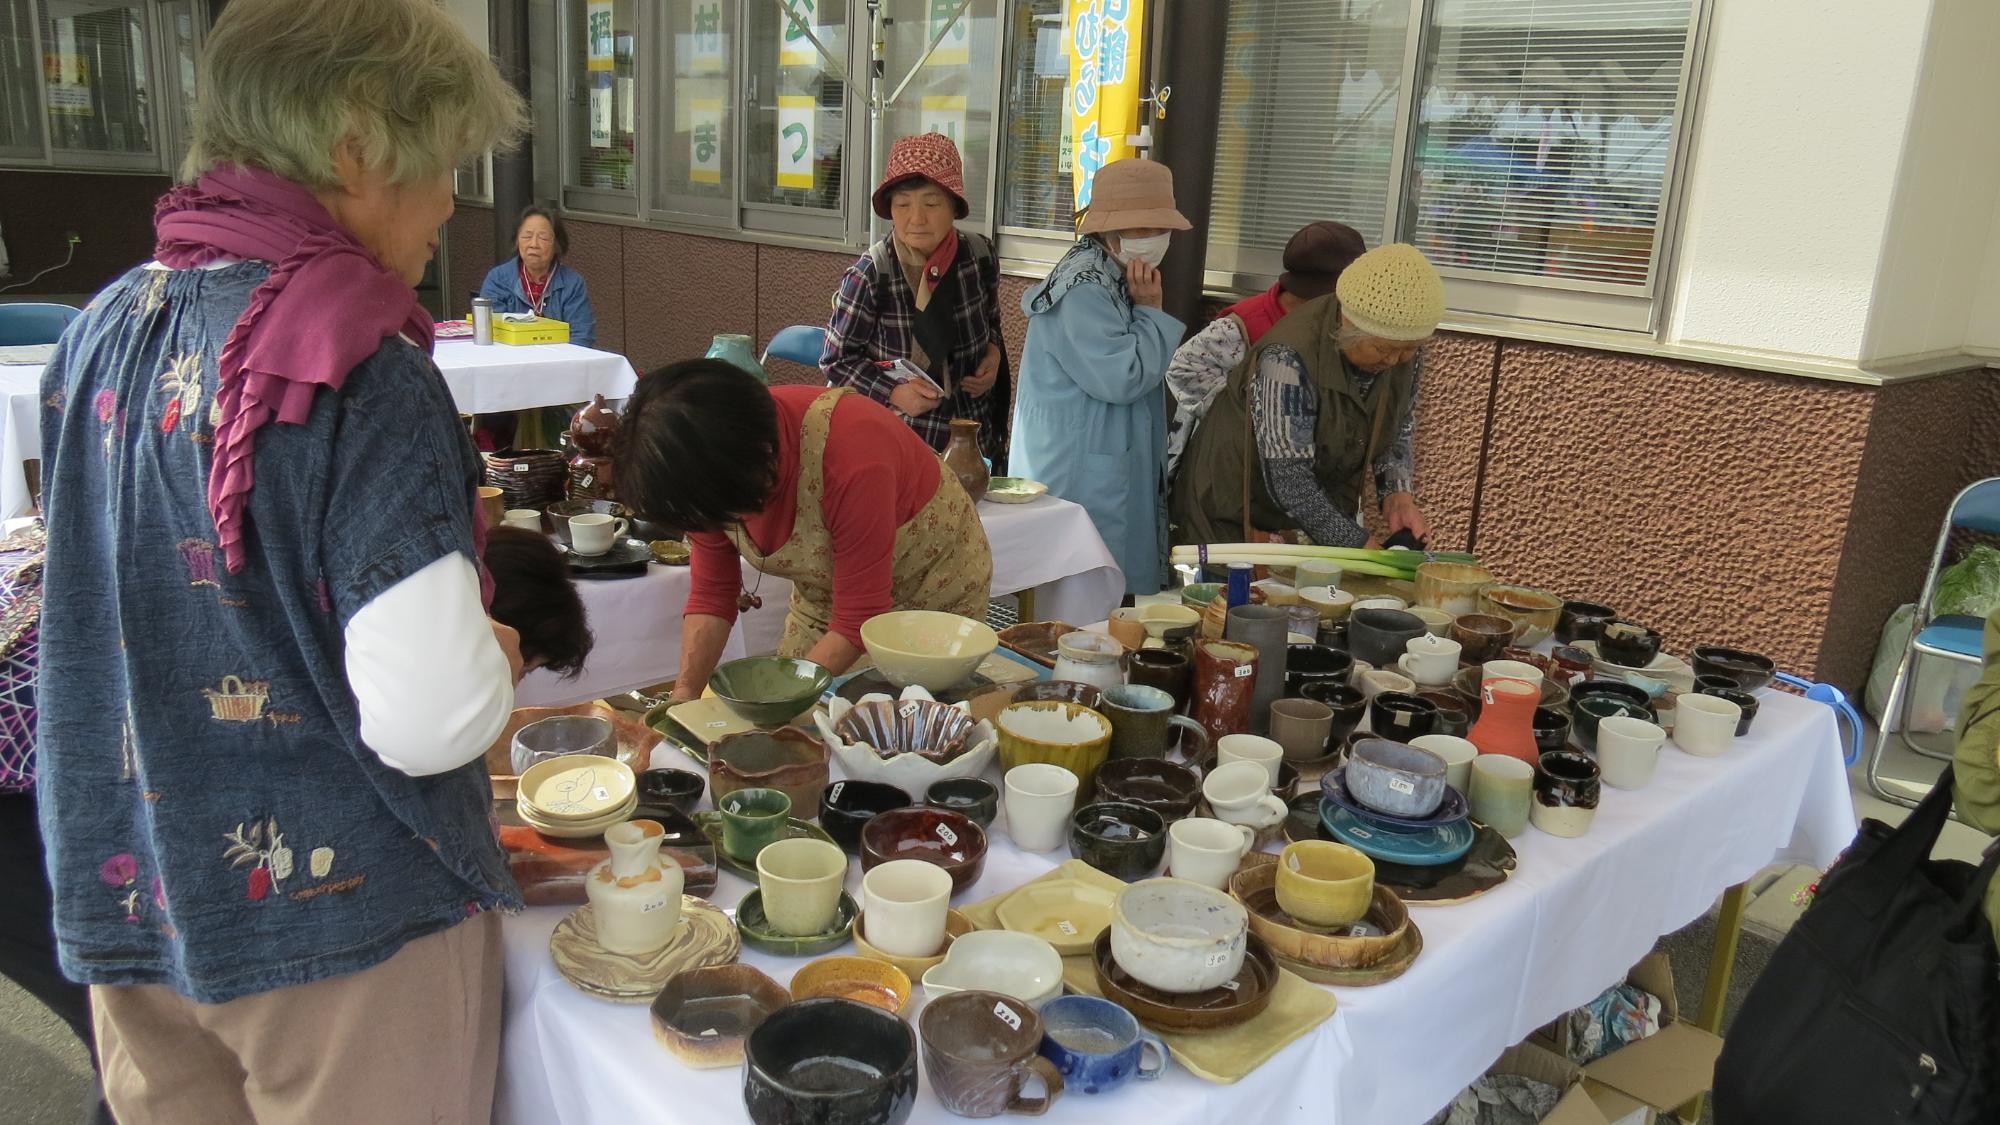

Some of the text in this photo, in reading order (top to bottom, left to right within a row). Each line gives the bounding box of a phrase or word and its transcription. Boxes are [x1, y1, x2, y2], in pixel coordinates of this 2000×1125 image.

[694, 3, 720, 53] 村
[694, 120, 809, 164] ま つ
[938, 826, 953, 841] 200
[996, 1009, 1016, 1025] 200
